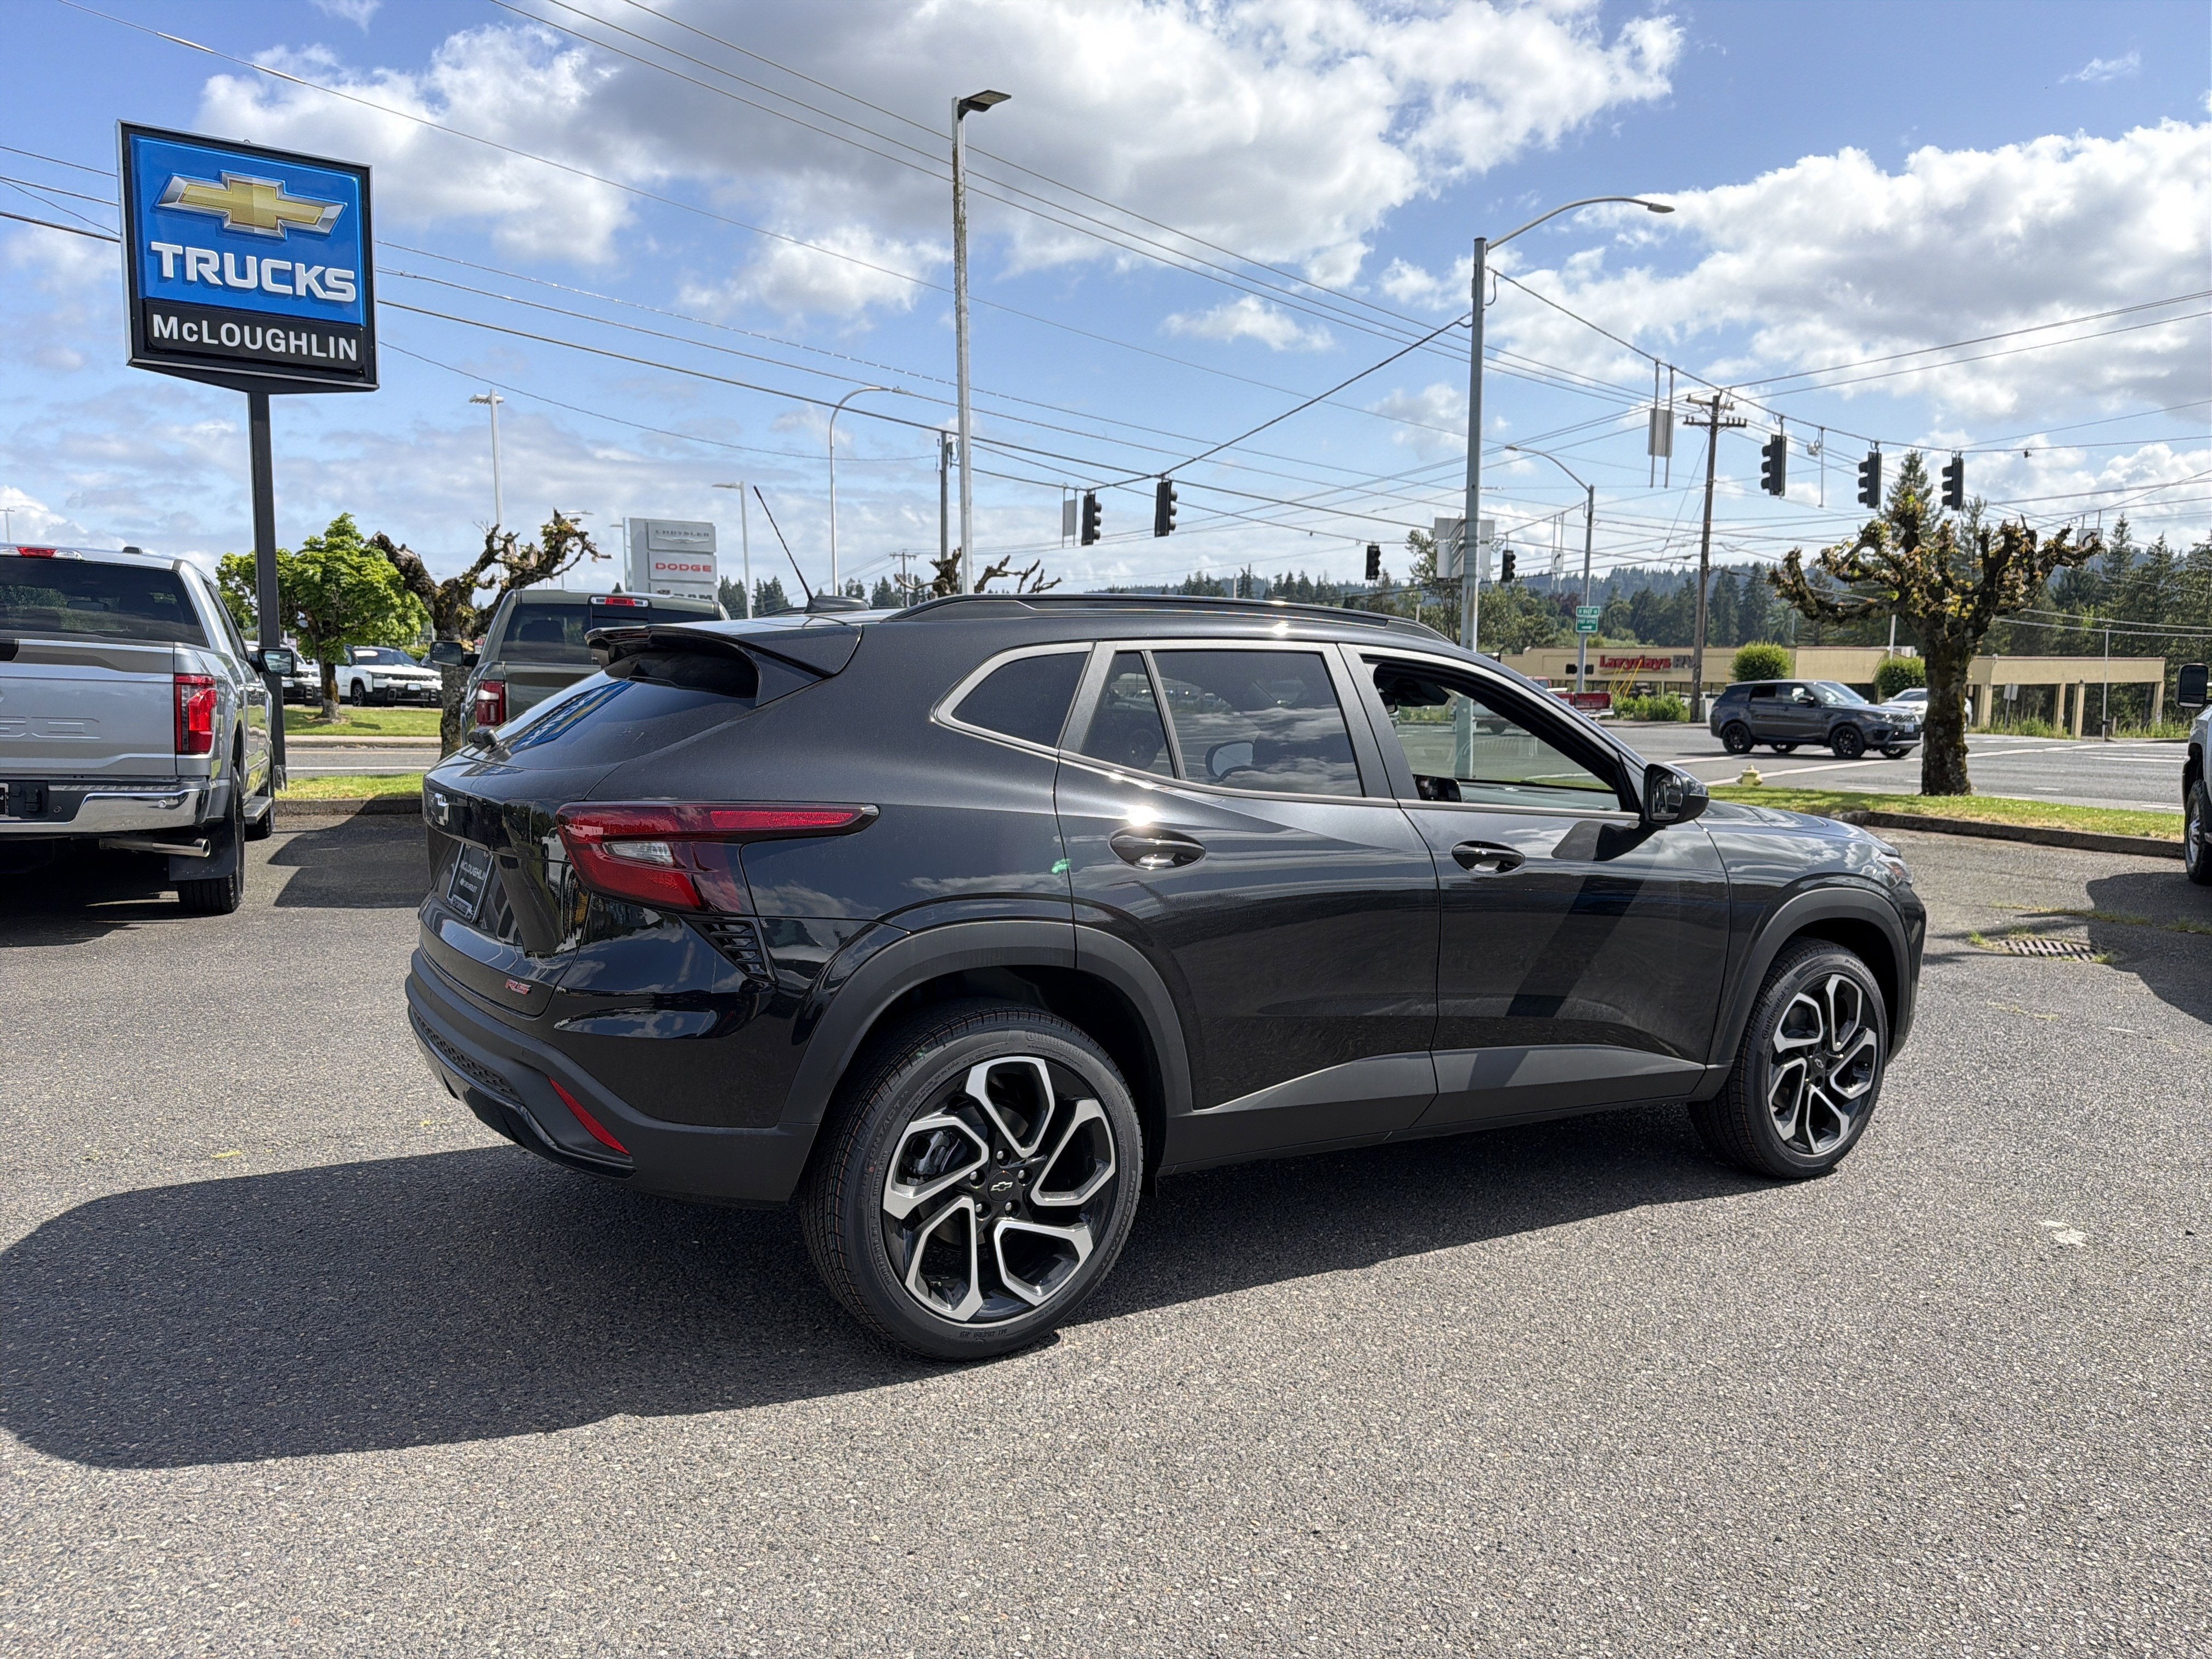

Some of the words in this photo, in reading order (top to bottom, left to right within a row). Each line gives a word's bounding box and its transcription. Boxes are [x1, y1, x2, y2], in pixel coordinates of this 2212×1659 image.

[151, 241, 356, 302] TRUCKS
[153, 314, 357, 362] McLOUGHLIN
[655, 529, 709, 537] CHRYSLER
[655, 562, 712, 572] DODGE
[1599, 654, 1672, 671] Lazydays
[505, 978, 532, 995] RS
[1101, 1170, 1137, 1270] PROCONTACT
